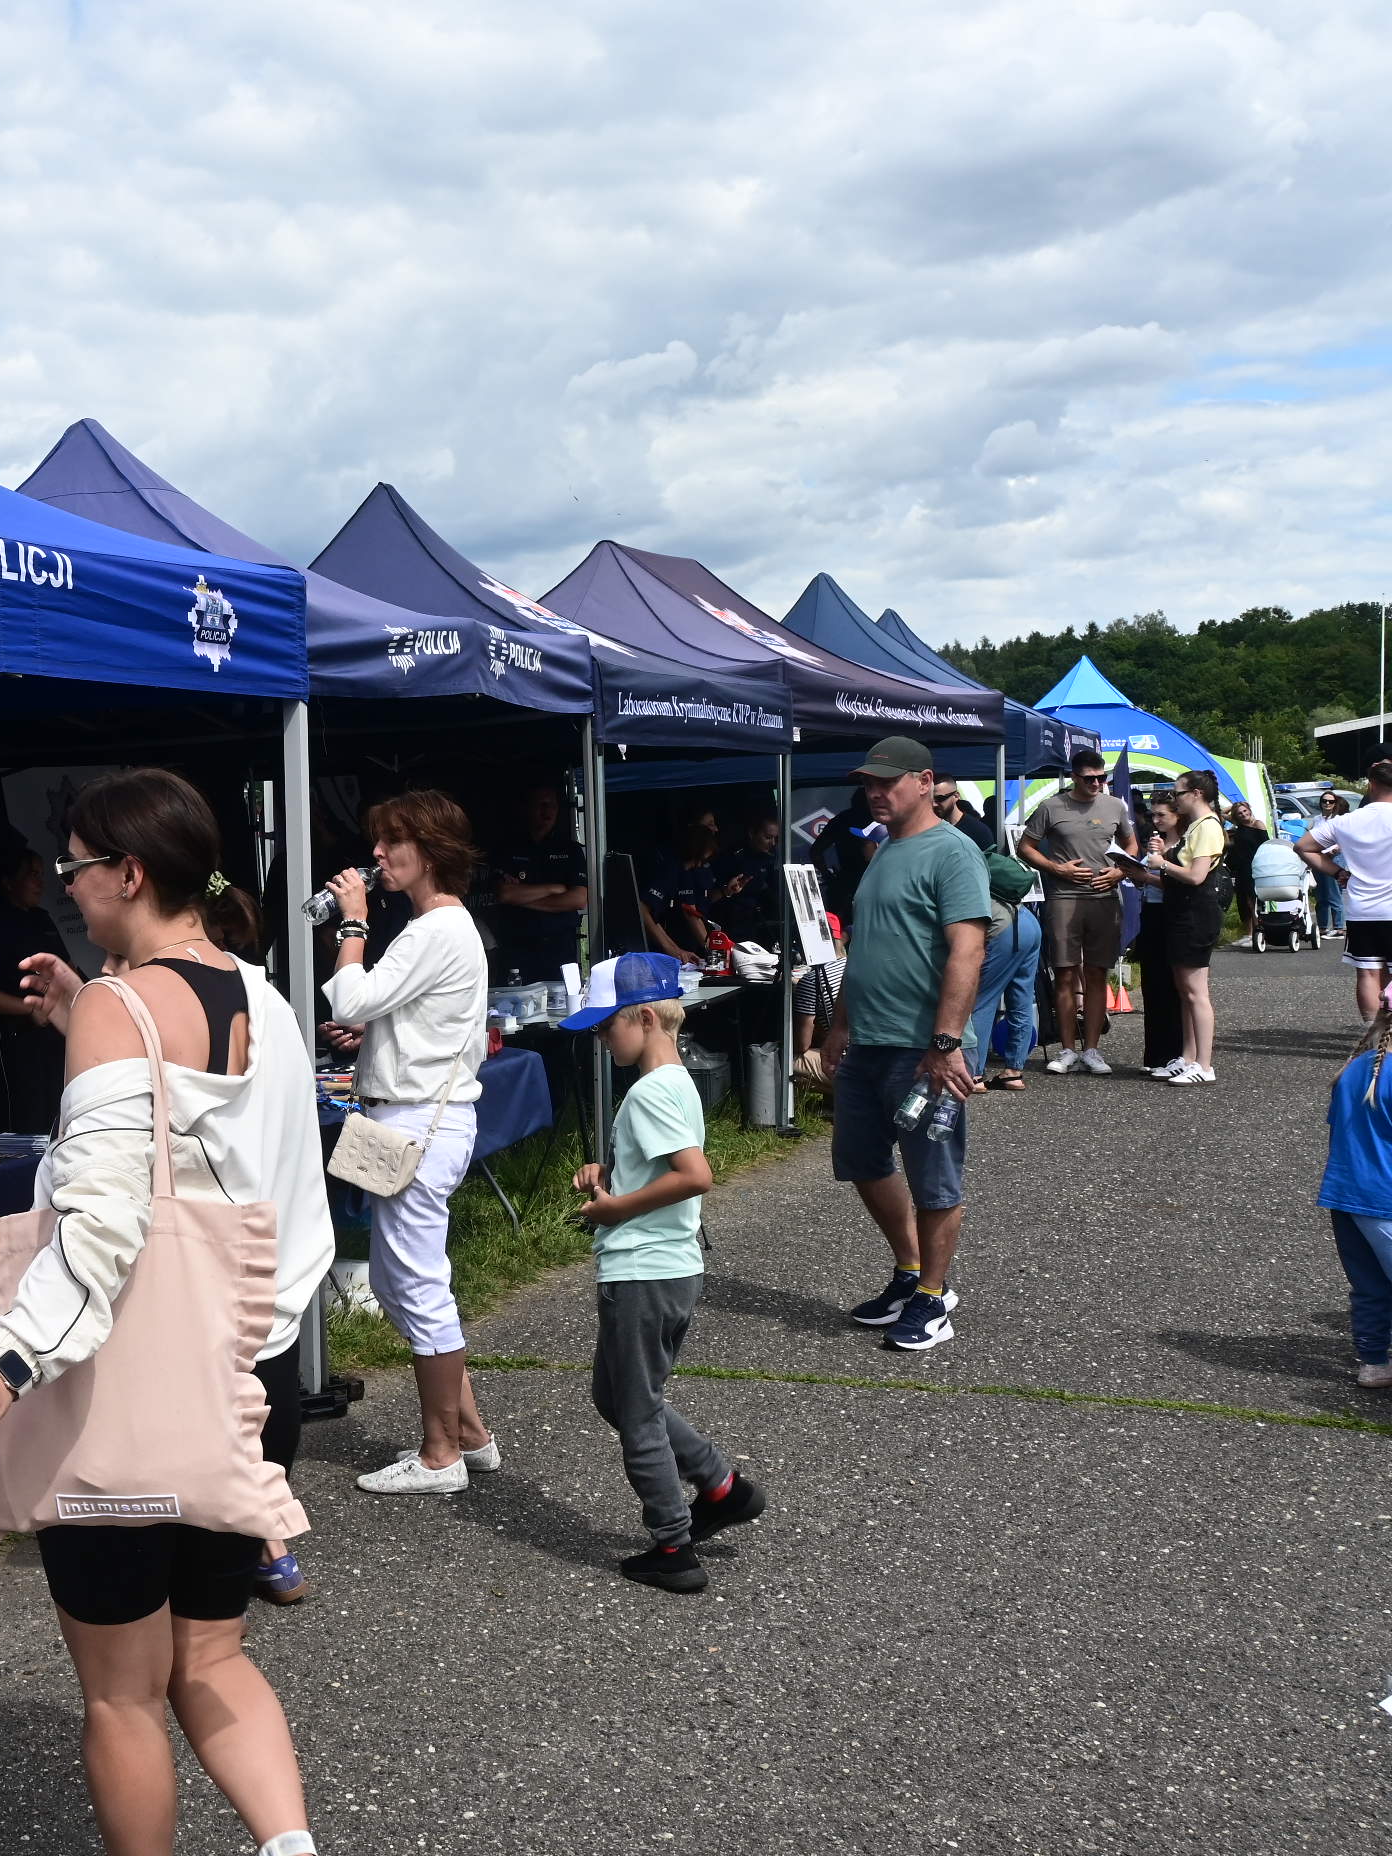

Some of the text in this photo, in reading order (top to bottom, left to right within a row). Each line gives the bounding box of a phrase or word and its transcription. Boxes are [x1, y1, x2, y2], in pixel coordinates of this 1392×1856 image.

[200, 629, 227, 642] POLICJA
[414, 630, 461, 656] POLICJA
[508, 642, 542, 673] POLICJA
[618, 691, 784, 729] Laboratorium Kryminalistyczne KWP w Poznaniu
[64, 1501, 172, 1513] intimissimi
